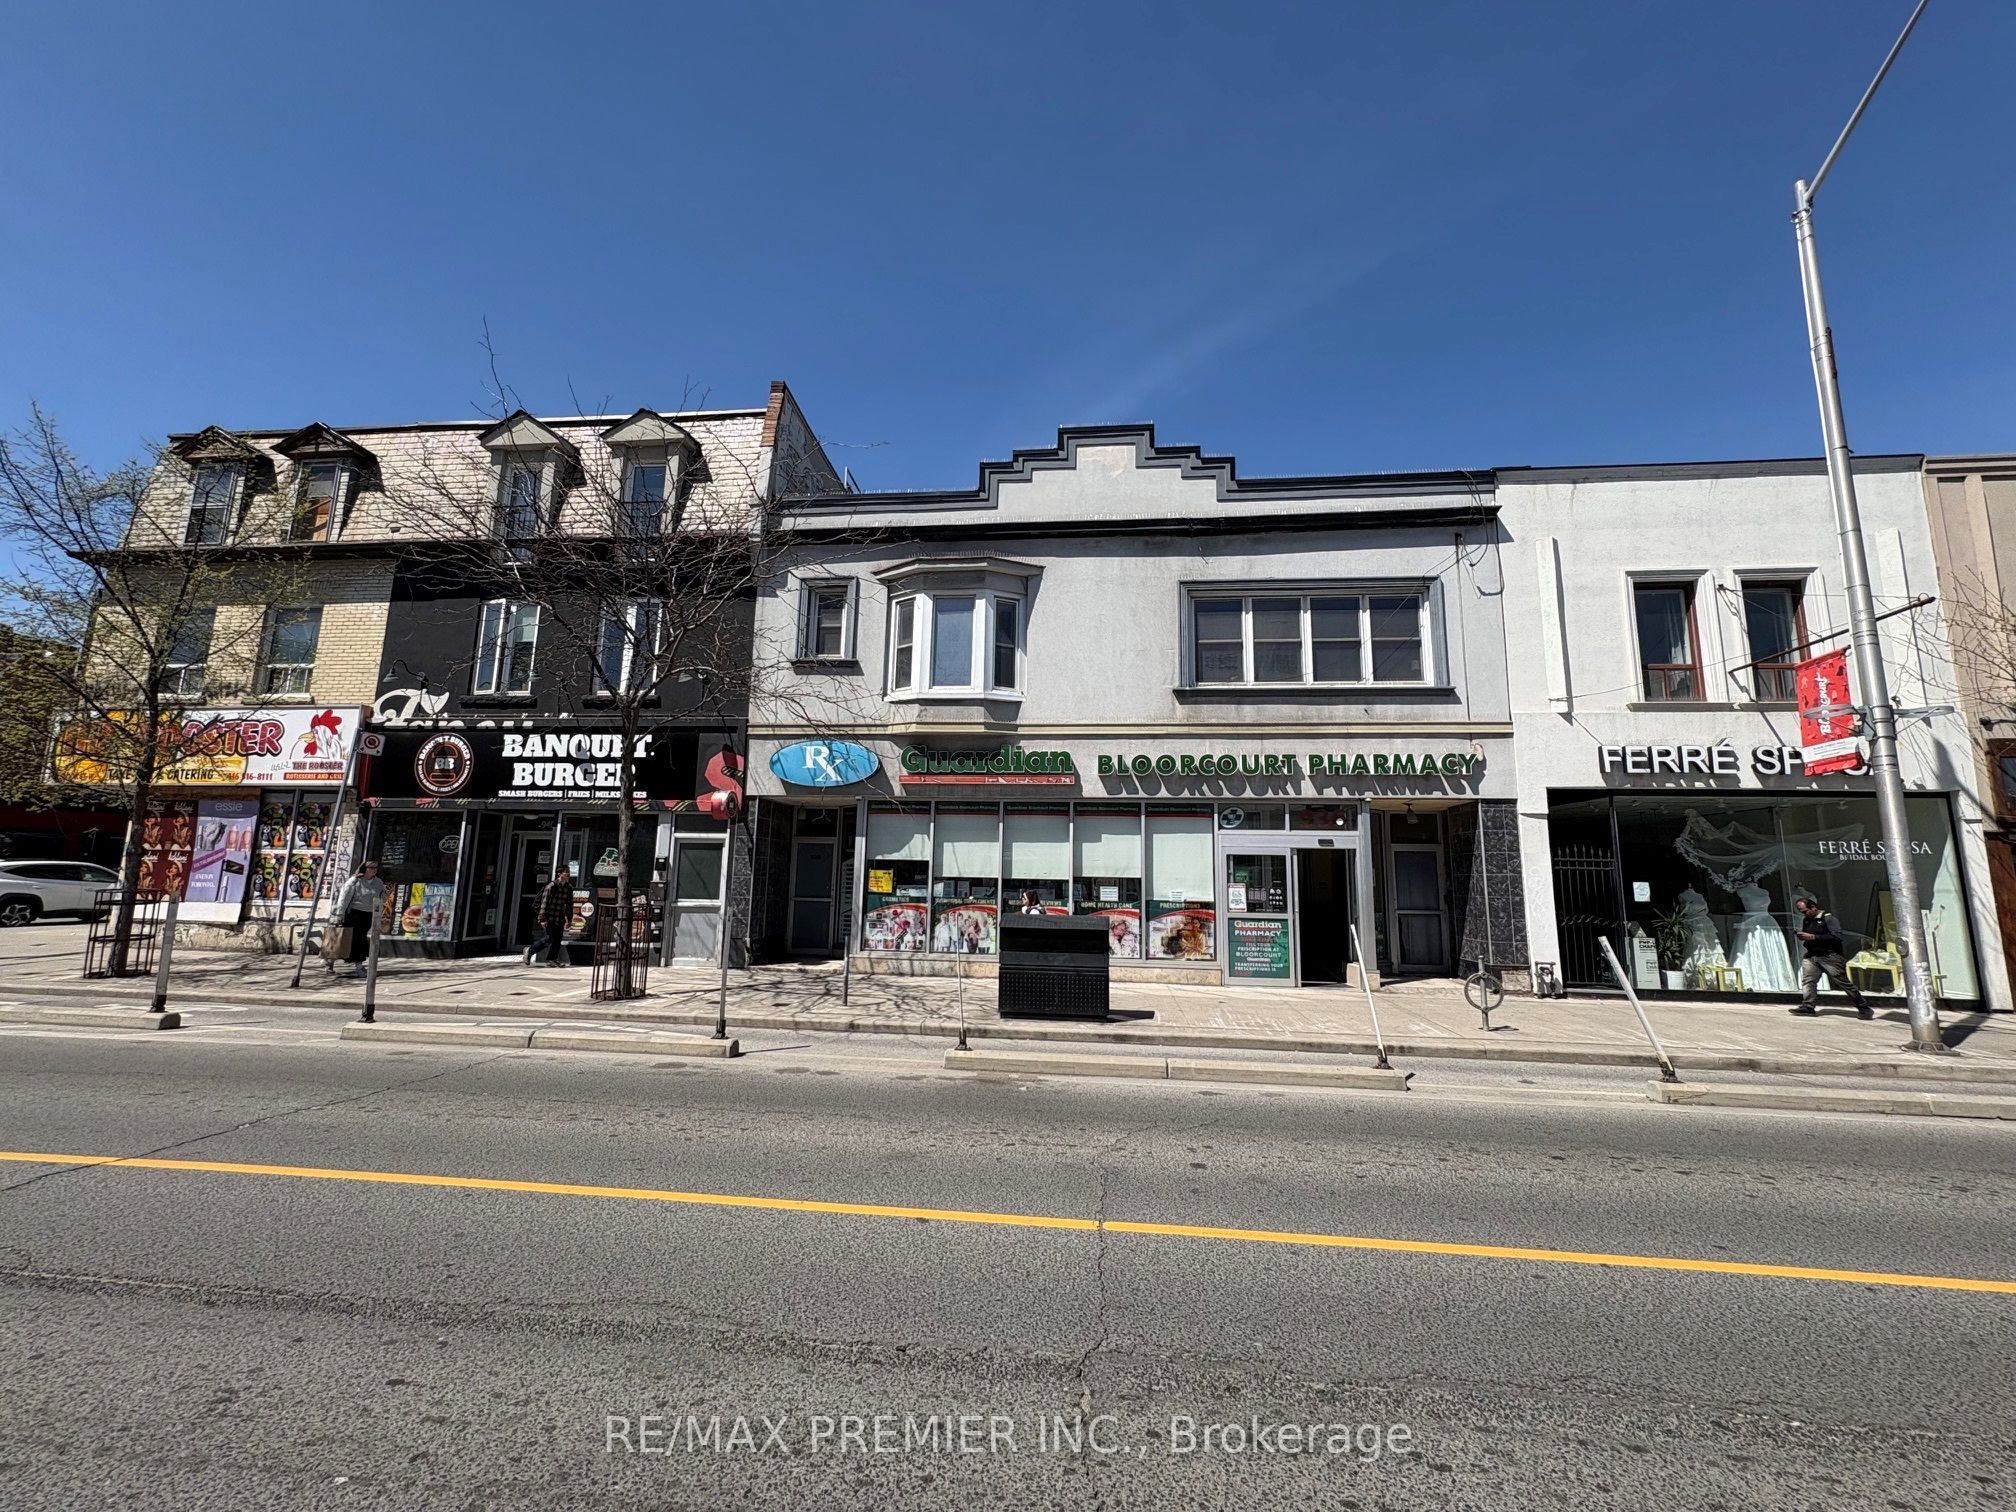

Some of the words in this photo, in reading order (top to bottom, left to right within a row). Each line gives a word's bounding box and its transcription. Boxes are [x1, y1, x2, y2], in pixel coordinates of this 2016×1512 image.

[900, 744, 1074, 774] Guardian
[1599, 738, 1739, 775] FERRÉ
[292, 762, 307, 770] THE
[308, 762, 344, 770] ROOSTER
[1098, 753, 1297, 776] BLOORCOURT
[1308, 753, 1478, 776] PHARMACY
[568, 790, 591, 798] FRIES
[215, 801, 243, 812] essie
[1818, 838, 1872, 854] FERRÉ
[1234, 920, 1282, 928] Guardian
